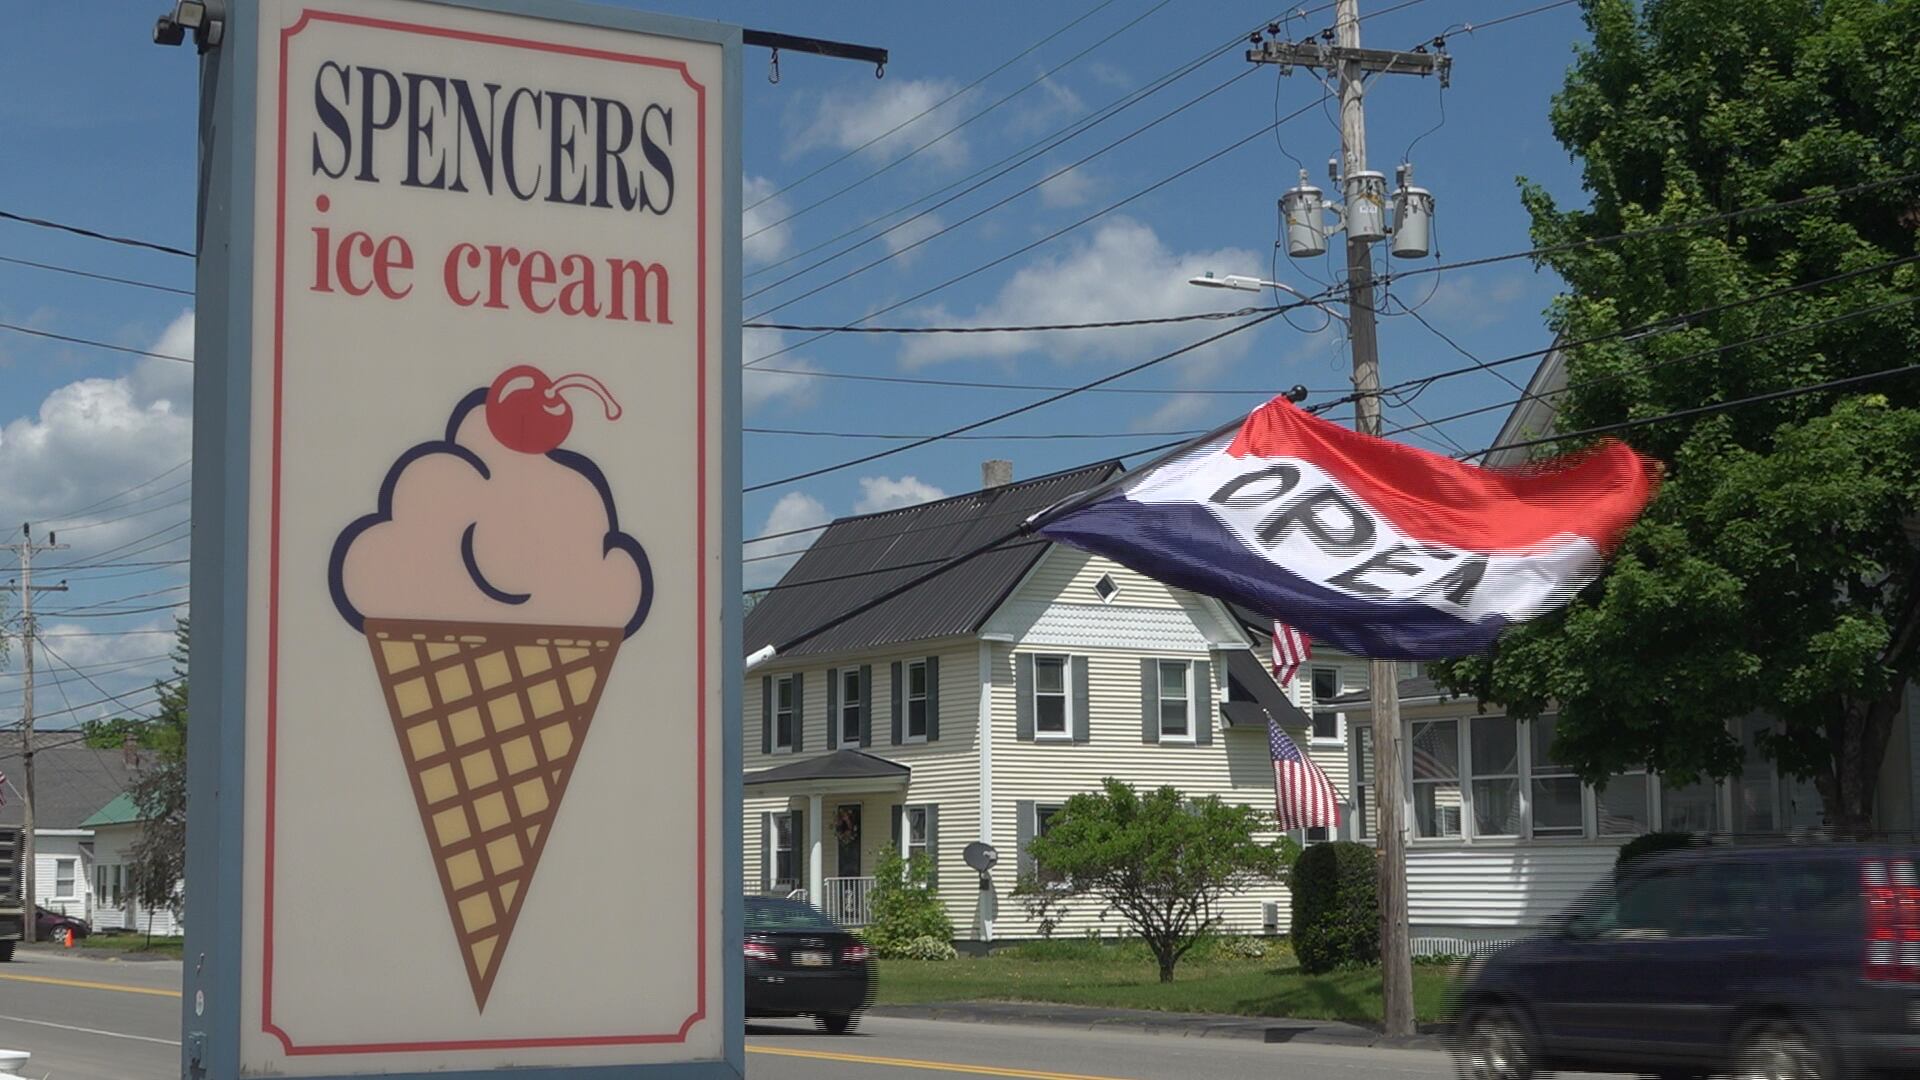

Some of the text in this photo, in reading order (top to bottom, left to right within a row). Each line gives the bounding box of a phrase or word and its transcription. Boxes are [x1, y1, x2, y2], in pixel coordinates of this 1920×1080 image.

[312, 60, 675, 216] SPENCERS
[310, 194, 674, 325] ice cream
